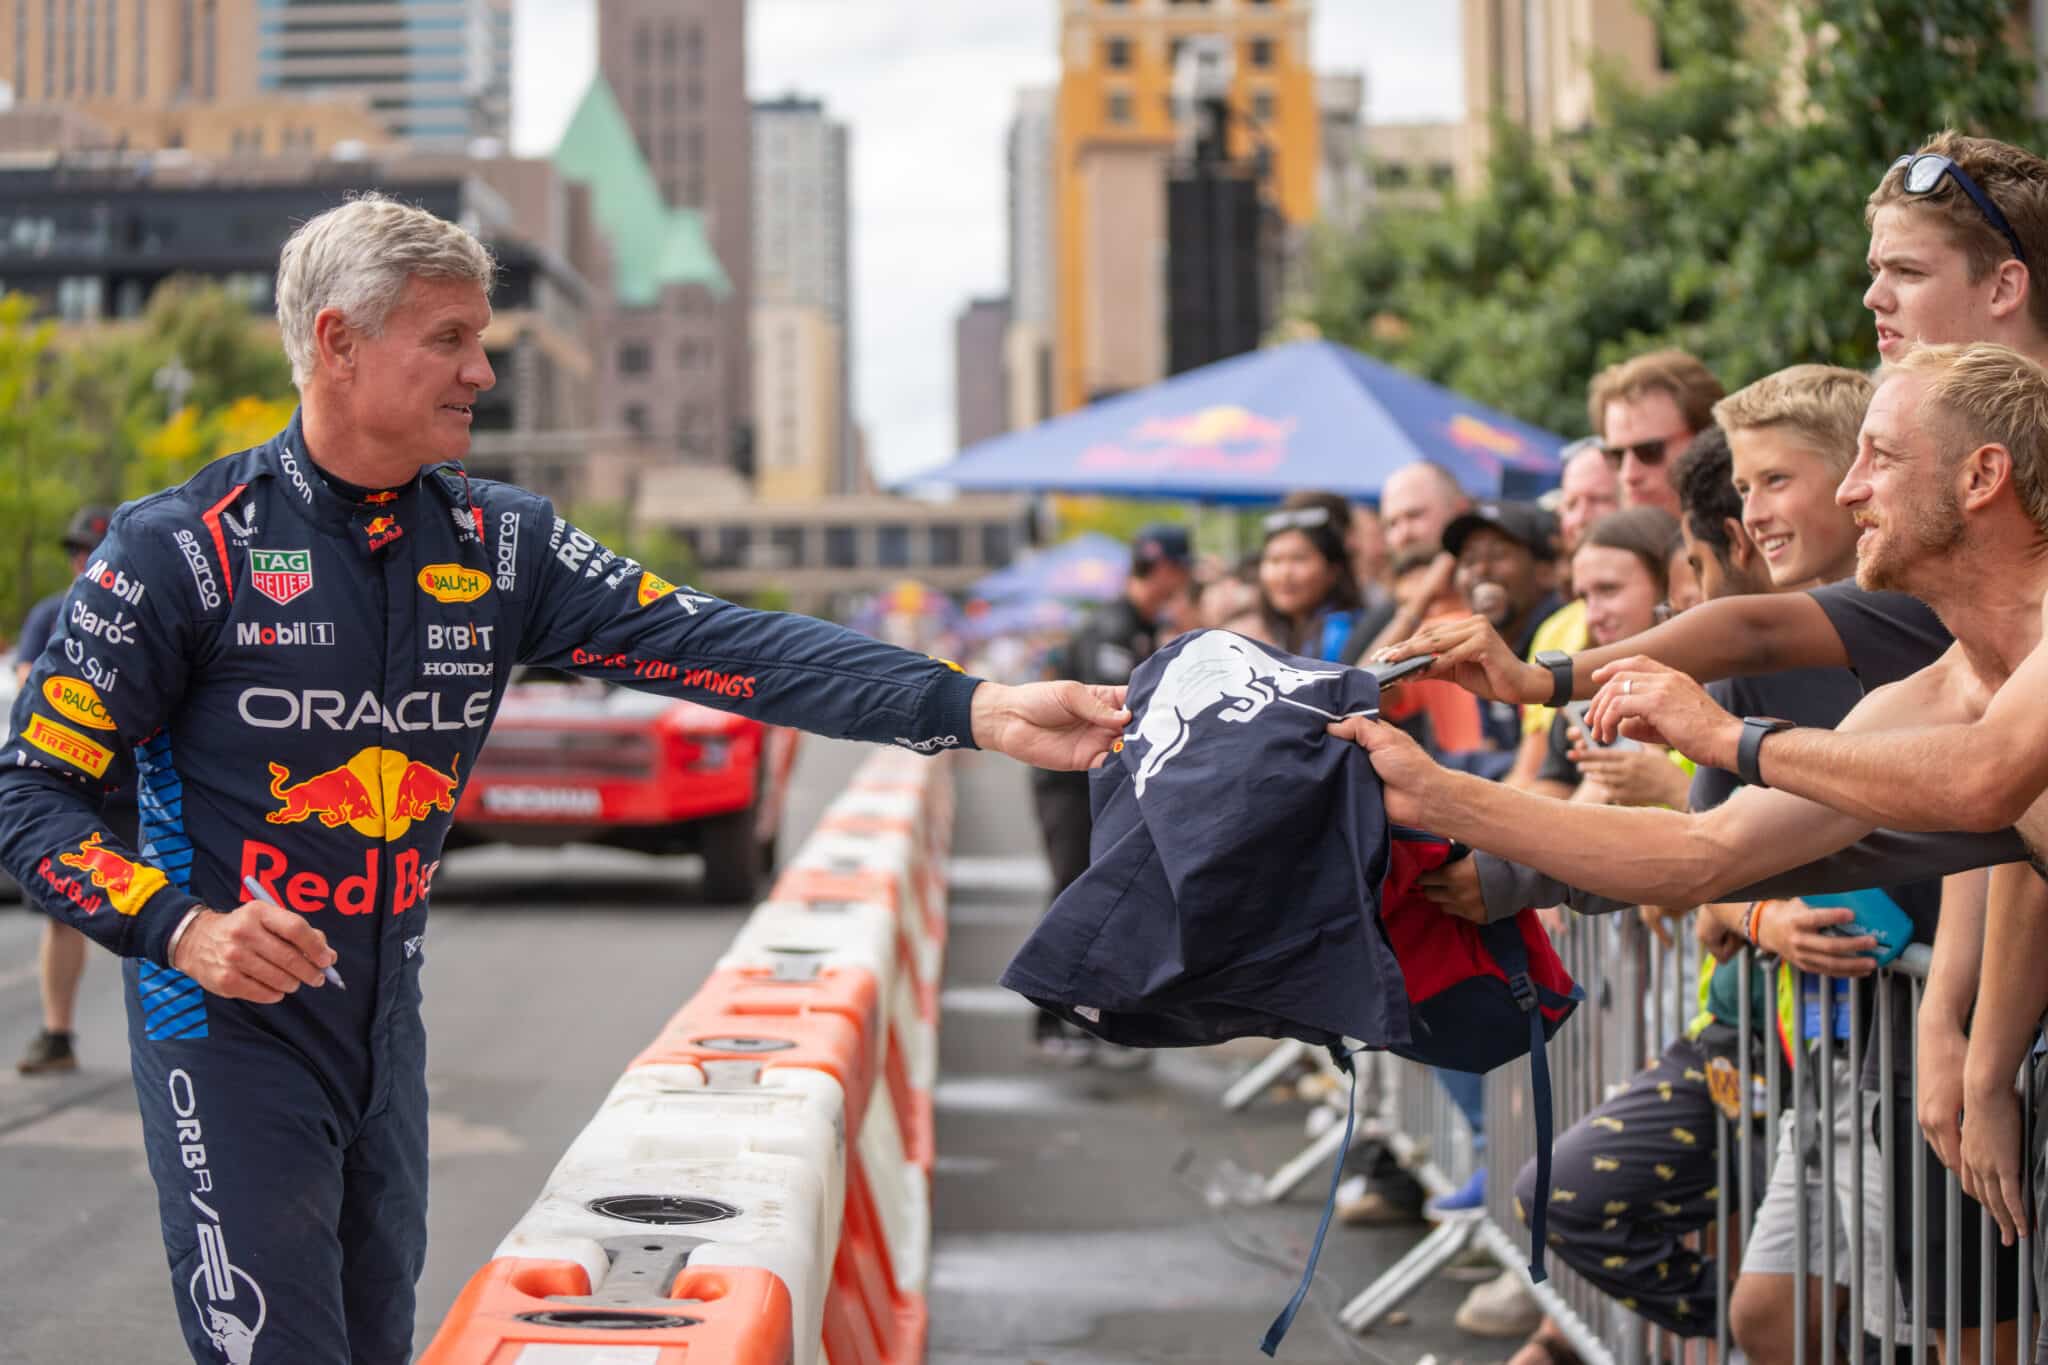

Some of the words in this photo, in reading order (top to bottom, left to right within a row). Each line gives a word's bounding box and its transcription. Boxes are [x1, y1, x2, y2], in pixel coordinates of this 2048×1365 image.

[280, 447, 313, 505] zoom
[173, 529, 221, 611] sparco
[255, 553, 306, 571] TAG
[496, 511, 520, 591] sparco
[556, 528, 599, 573] RO
[85, 559, 145, 606] Mobil
[255, 573, 309, 600] HEUER
[71, 600, 123, 644] Claro
[237, 622, 307, 646] Mobil
[313, 623, 331, 644] 1
[81, 657, 118, 692] Sui
[683, 669, 756, 698] WINGS
[238, 687, 492, 733] ORACLE
[31, 721, 103, 769] PIRELLI
[37, 857, 71, 893] Red
[67, 880, 102, 915] Bull
[239, 839, 379, 916] Red
[393, 848, 440, 916] Bu
